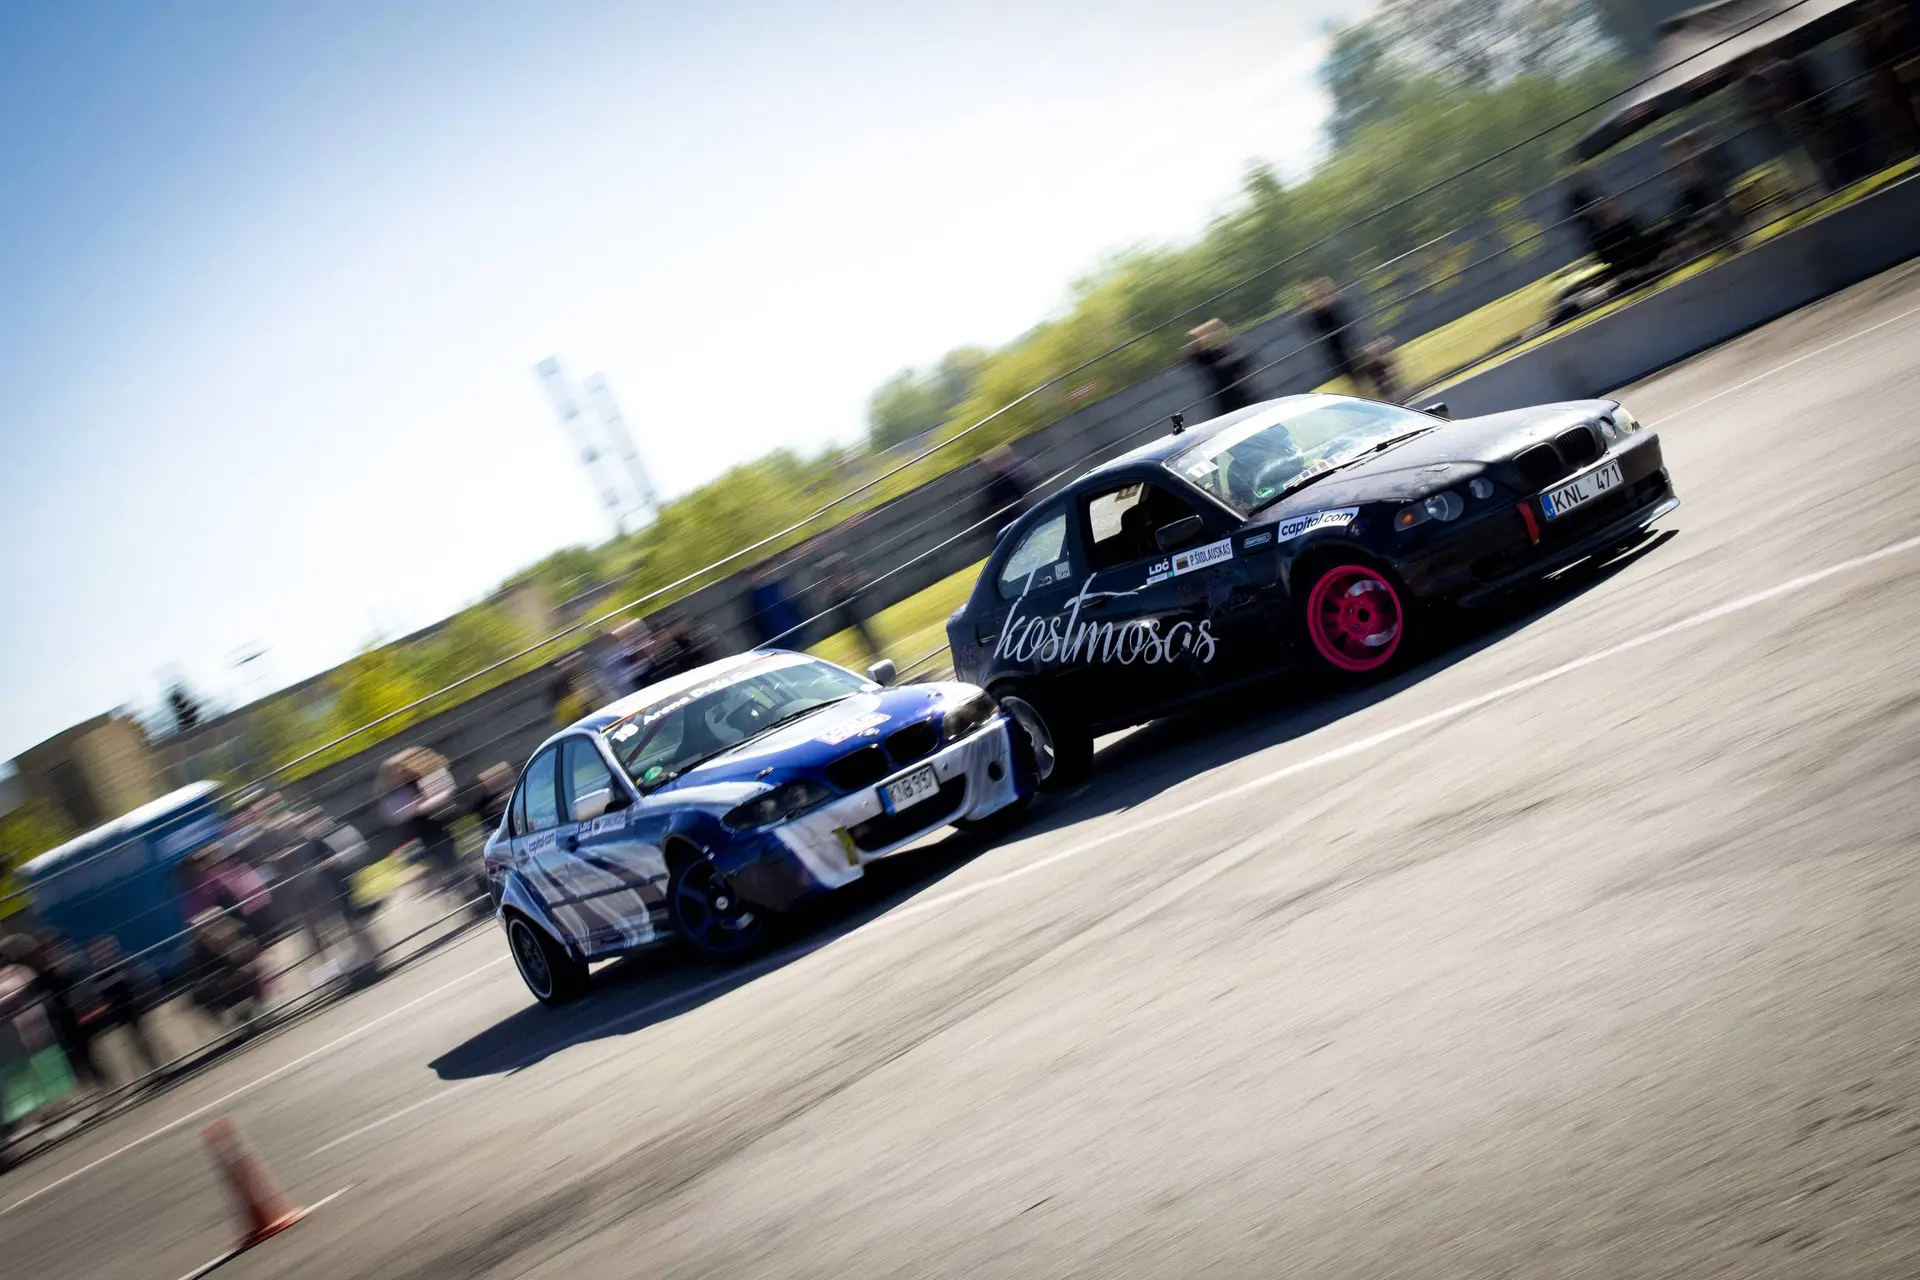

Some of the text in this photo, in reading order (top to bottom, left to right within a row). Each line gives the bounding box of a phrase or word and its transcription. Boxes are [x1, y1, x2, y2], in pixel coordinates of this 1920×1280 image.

[1552, 464, 1620, 512] KNL 471
[1281, 512, 1354, 536] capital.com
[1546, 508, 1555, 517] LT
